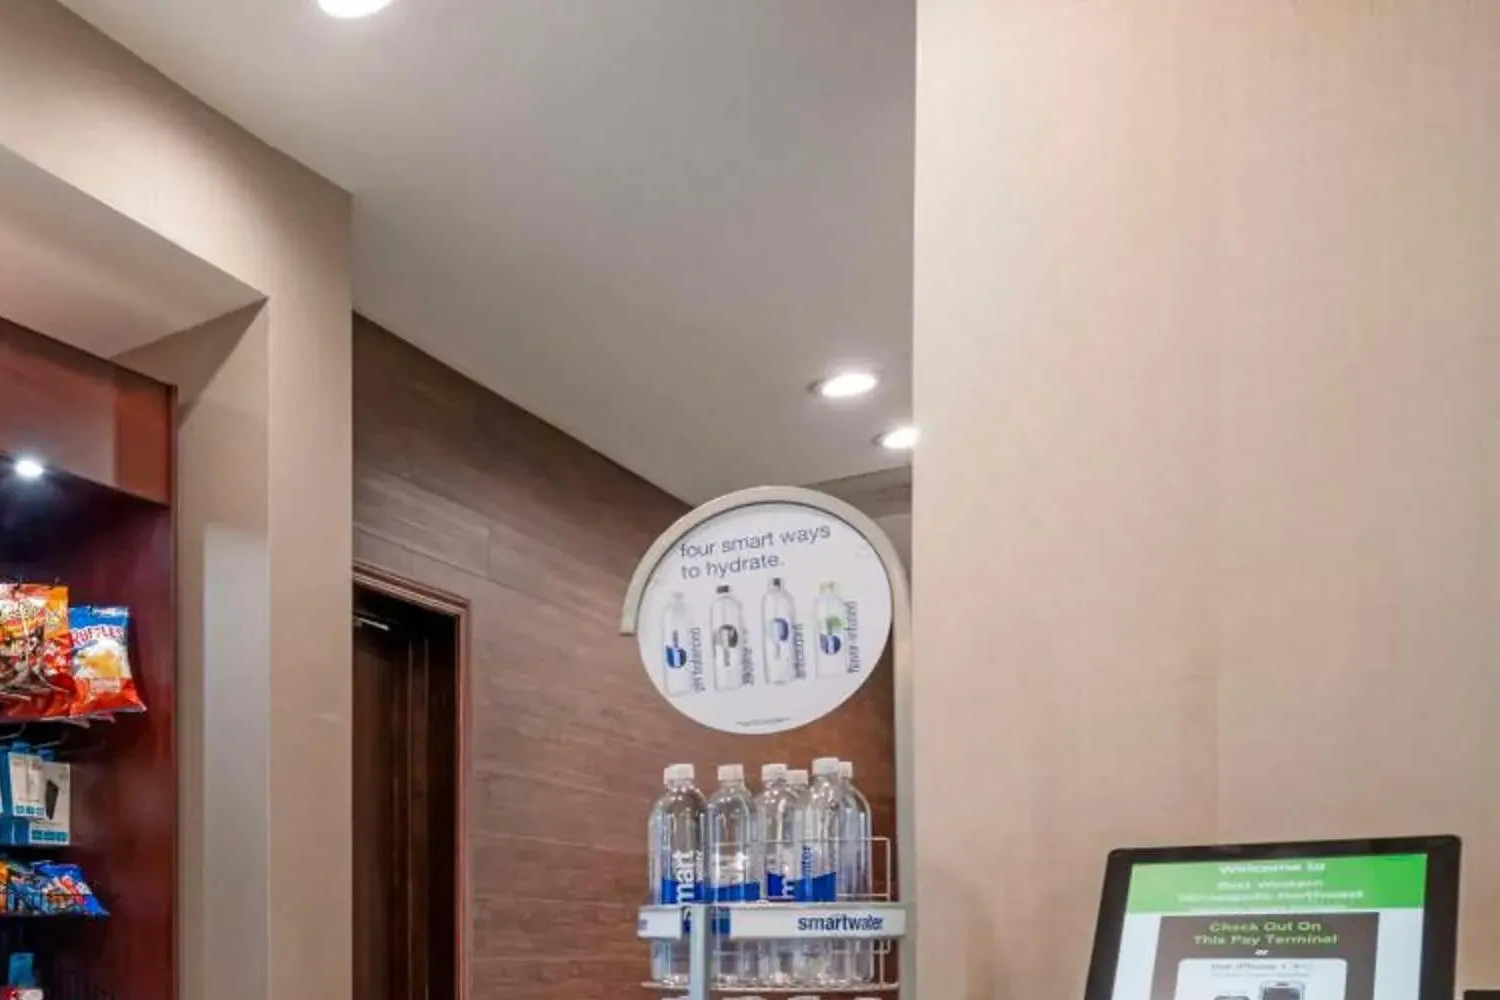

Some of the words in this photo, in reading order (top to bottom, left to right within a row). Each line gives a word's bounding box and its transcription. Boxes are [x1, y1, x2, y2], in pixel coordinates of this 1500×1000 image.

[679, 540, 715, 559] four
[721, 531, 774, 554] smart
[780, 523, 831, 547] ways
[681, 564, 700, 580] to
[706, 553, 784, 579] hydrate.
[797, 914, 884, 931] smartwater
[1209, 921, 1259, 933] Check
[1264, 921, 1294, 932] Out
[1299, 921, 1321, 931] On
[1194, 934, 1226, 945] This
[1231, 934, 1261, 947] Pay
[1266, 933, 1338, 945] Terminal
